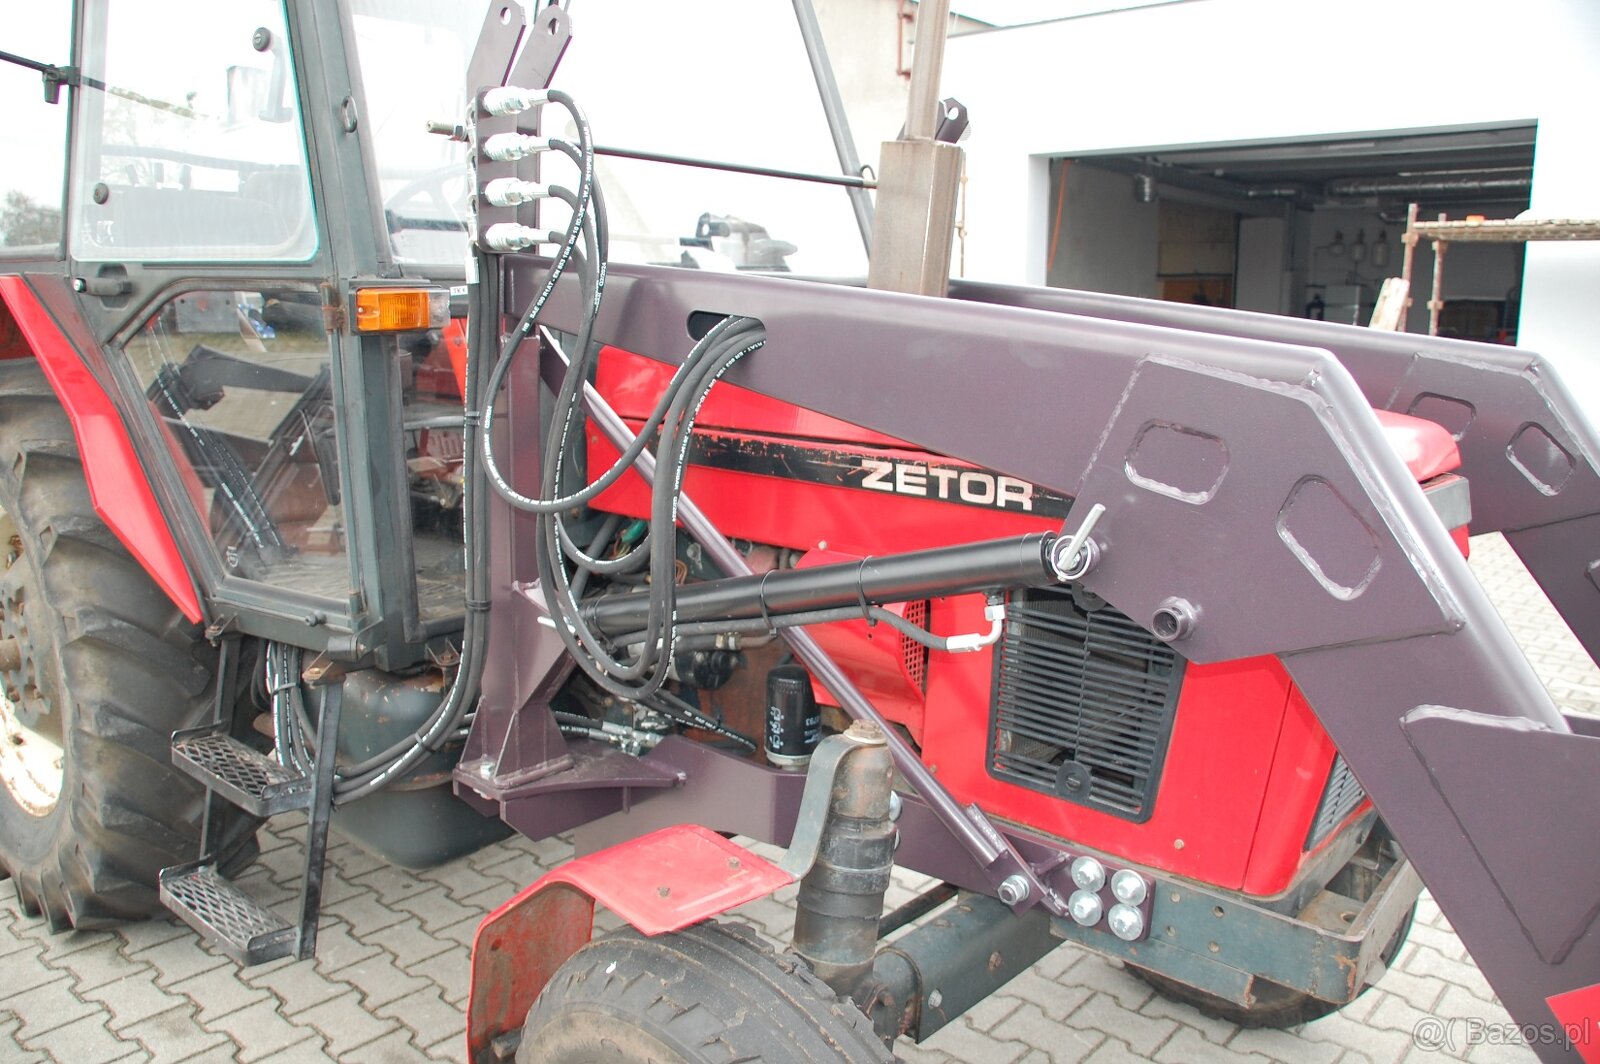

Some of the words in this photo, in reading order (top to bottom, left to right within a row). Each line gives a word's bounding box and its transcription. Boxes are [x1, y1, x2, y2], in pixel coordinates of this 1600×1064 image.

[530, 306, 540, 319] SAE
[537, 296, 546, 307] 100
[543, 280, 554, 296] R1AT
[552, 268, 560, 280] EN
[558, 258, 566, 270] 853
[562, 246, 572, 258] 1SN
[568, 234, 577, 245] DN
[861, 459, 1032, 511] ZETOR
